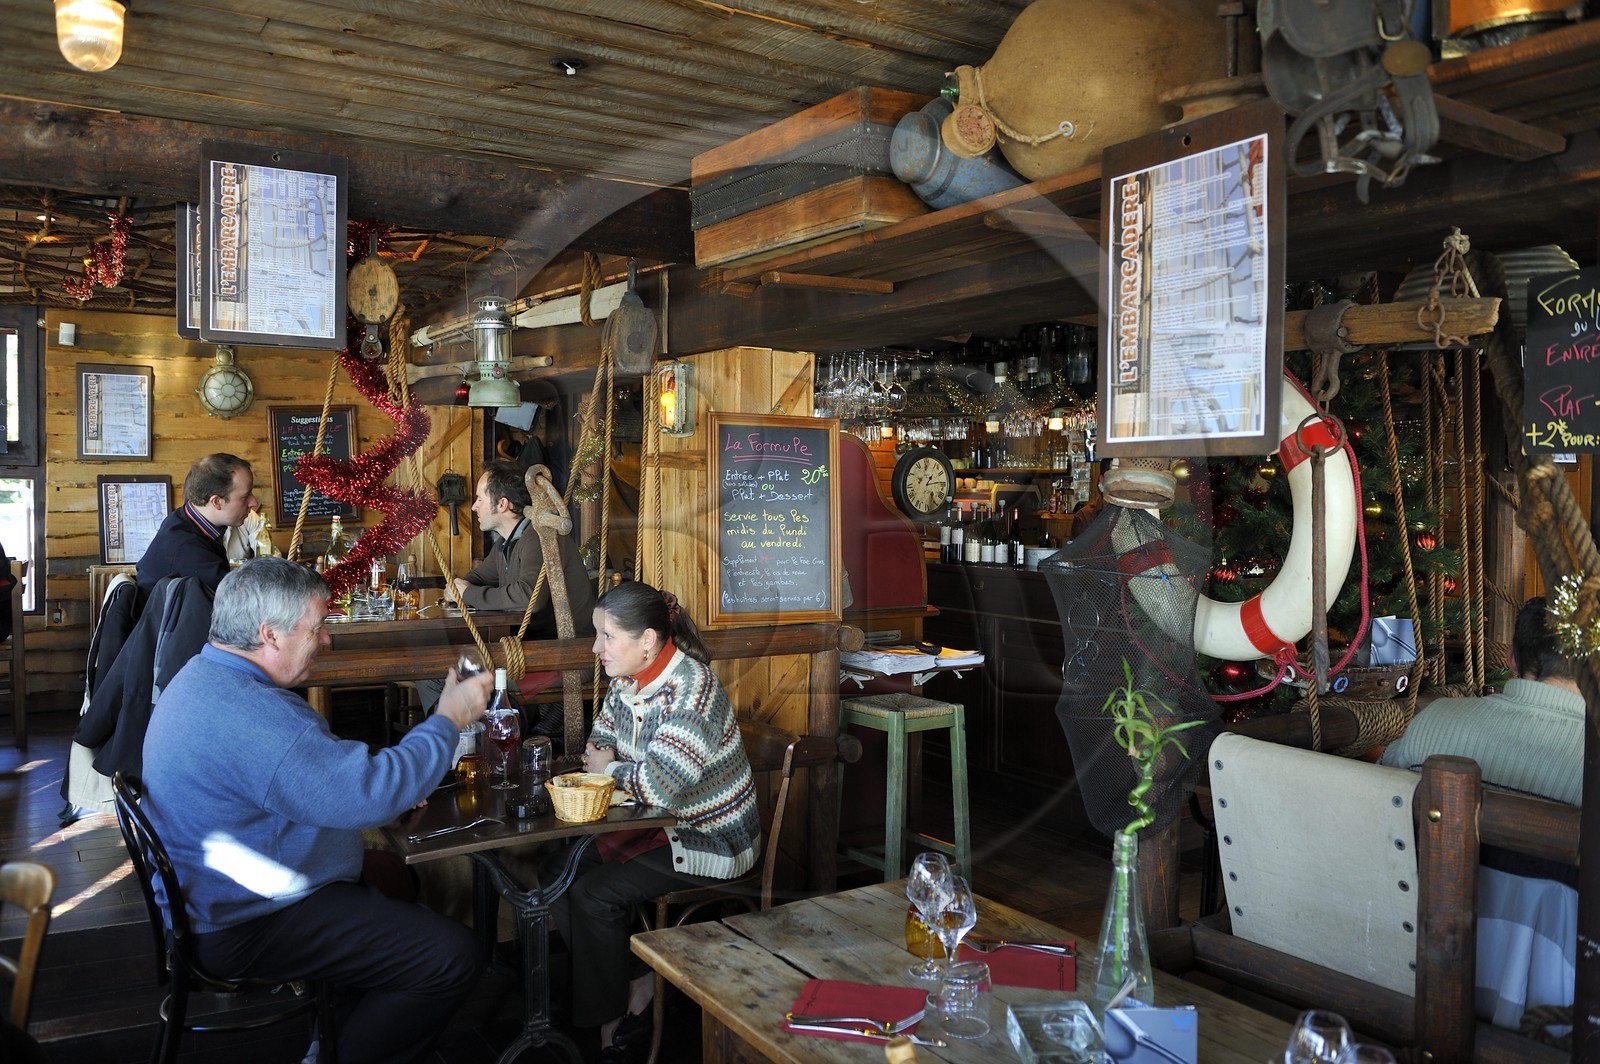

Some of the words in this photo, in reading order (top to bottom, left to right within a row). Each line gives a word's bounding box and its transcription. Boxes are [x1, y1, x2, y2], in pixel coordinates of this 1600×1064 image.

[1537, 275, 1600, 321] FORM
[725, 433, 743, 452] La
[748, 433, 812, 456] Formule
[725, 469, 755, 481] Entrée
[765, 488, 813, 501] Dessert
[762, 508, 786, 522] tous
[790, 508, 810, 523] les
[726, 522, 757, 535] midis
[762, 523, 775, 535] du
[780, 523, 807, 537] lundi
[741, 540, 757, 549] au
